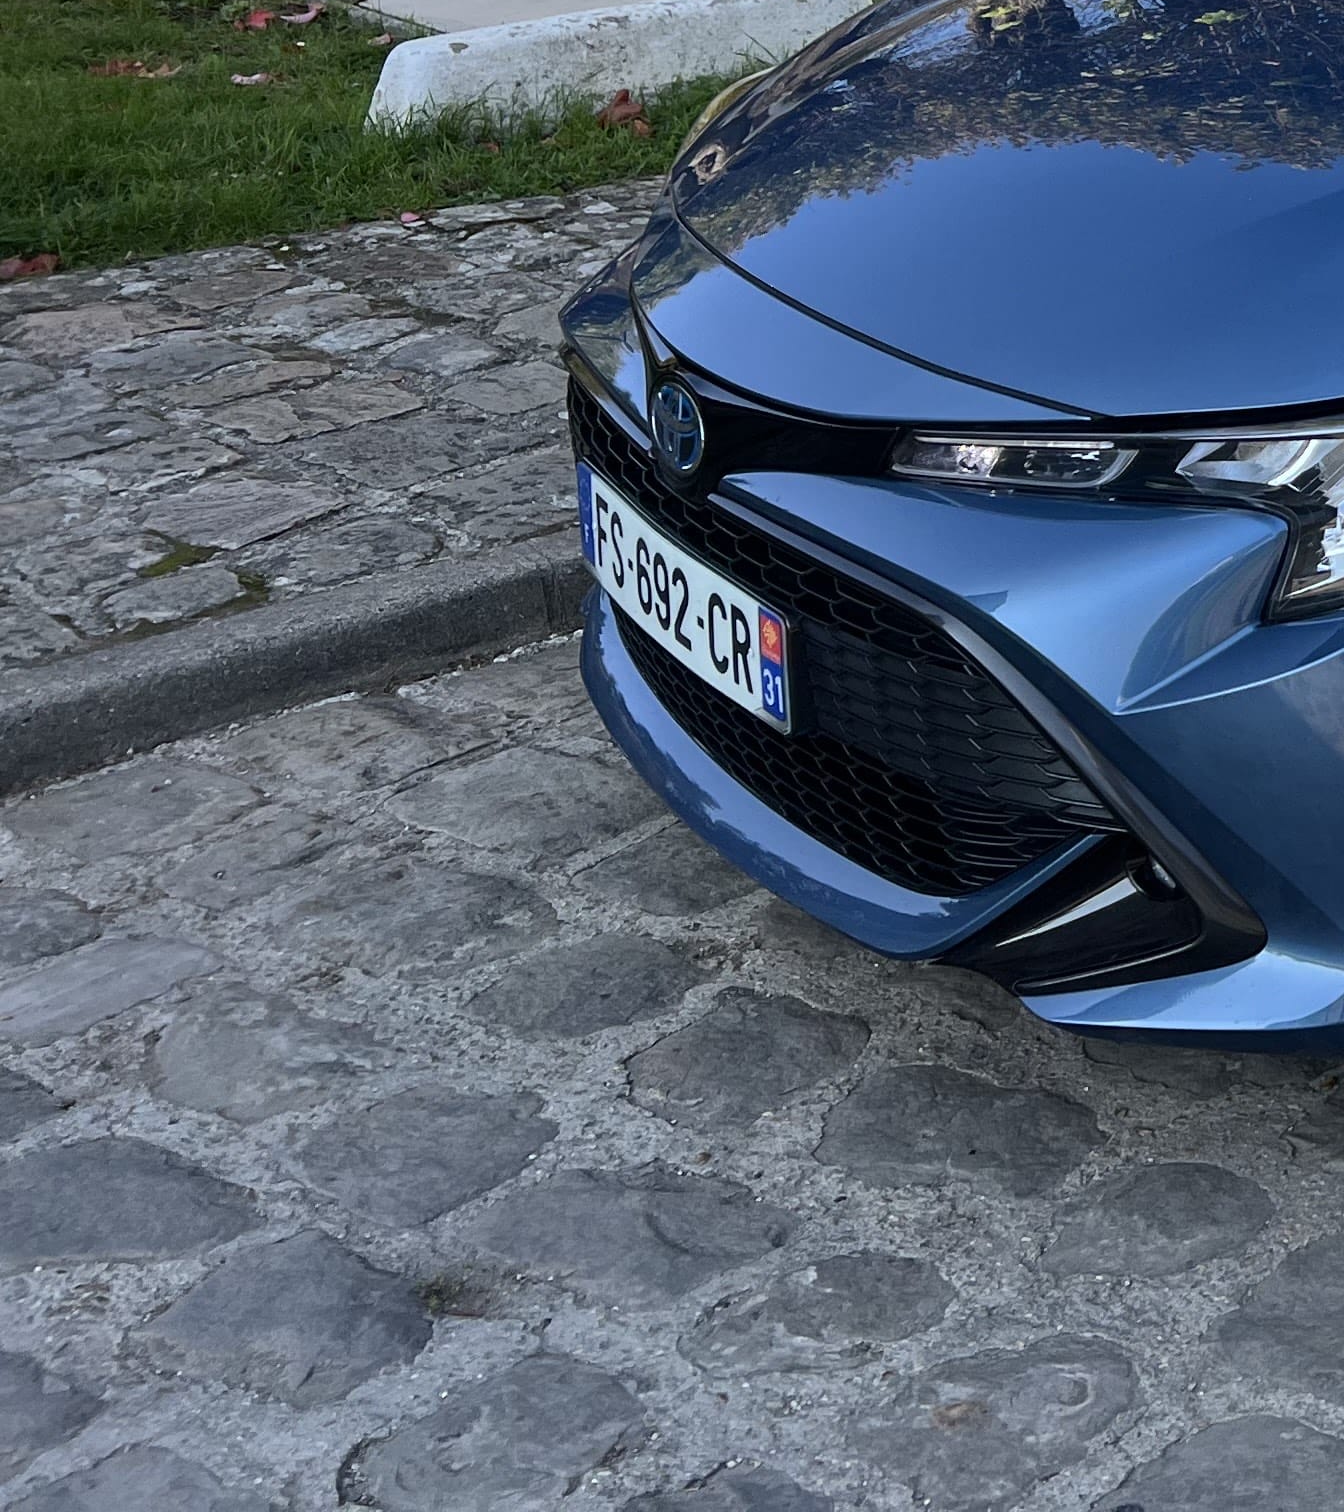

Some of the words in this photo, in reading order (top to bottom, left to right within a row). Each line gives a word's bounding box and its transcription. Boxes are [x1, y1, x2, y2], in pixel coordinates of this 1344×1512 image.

[584, 523, 591, 543] F
[596, 492, 754, 695] FS-692-CR
[763, 668, 784, 714] 31
